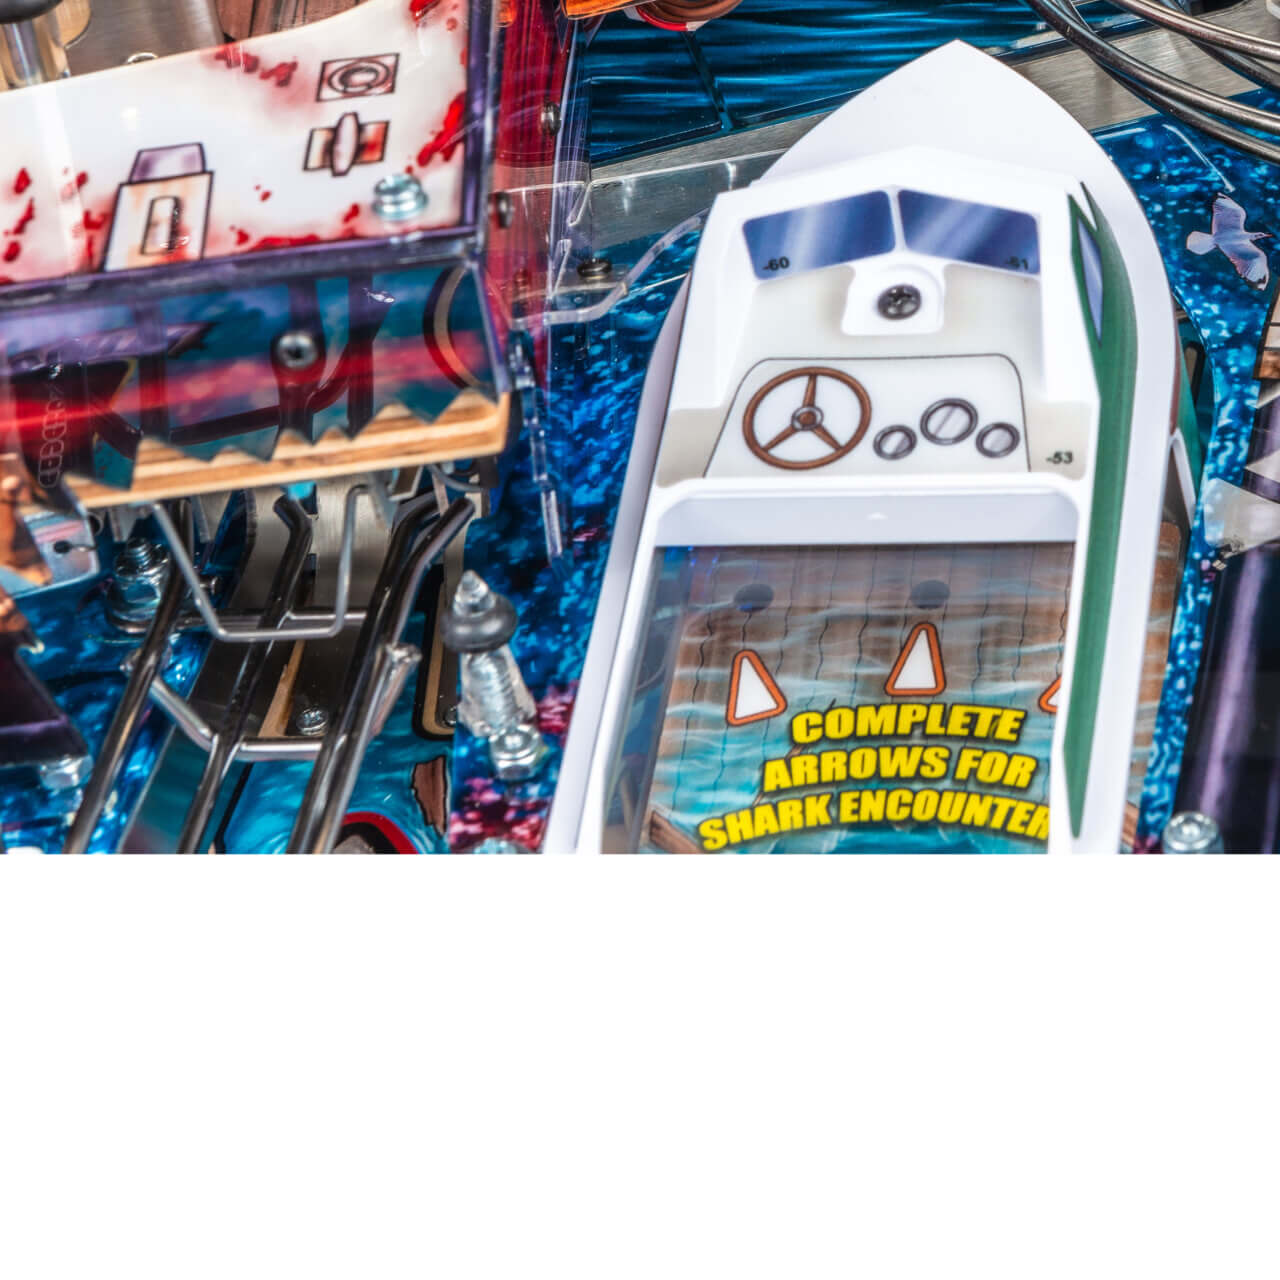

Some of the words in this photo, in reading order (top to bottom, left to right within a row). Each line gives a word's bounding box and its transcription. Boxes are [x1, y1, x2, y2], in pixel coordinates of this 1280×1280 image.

[762, 256, 790, 271] -60
[1045, 451, 1074, 465] -53
[792, 703, 1026, 744] COMPLETE
[763, 745, 950, 792] ARROWS
[954, 747, 1037, 789] FOR
[698, 793, 833, 851] SHARK
[840, 788, 1050, 841] ENCOUNTER
